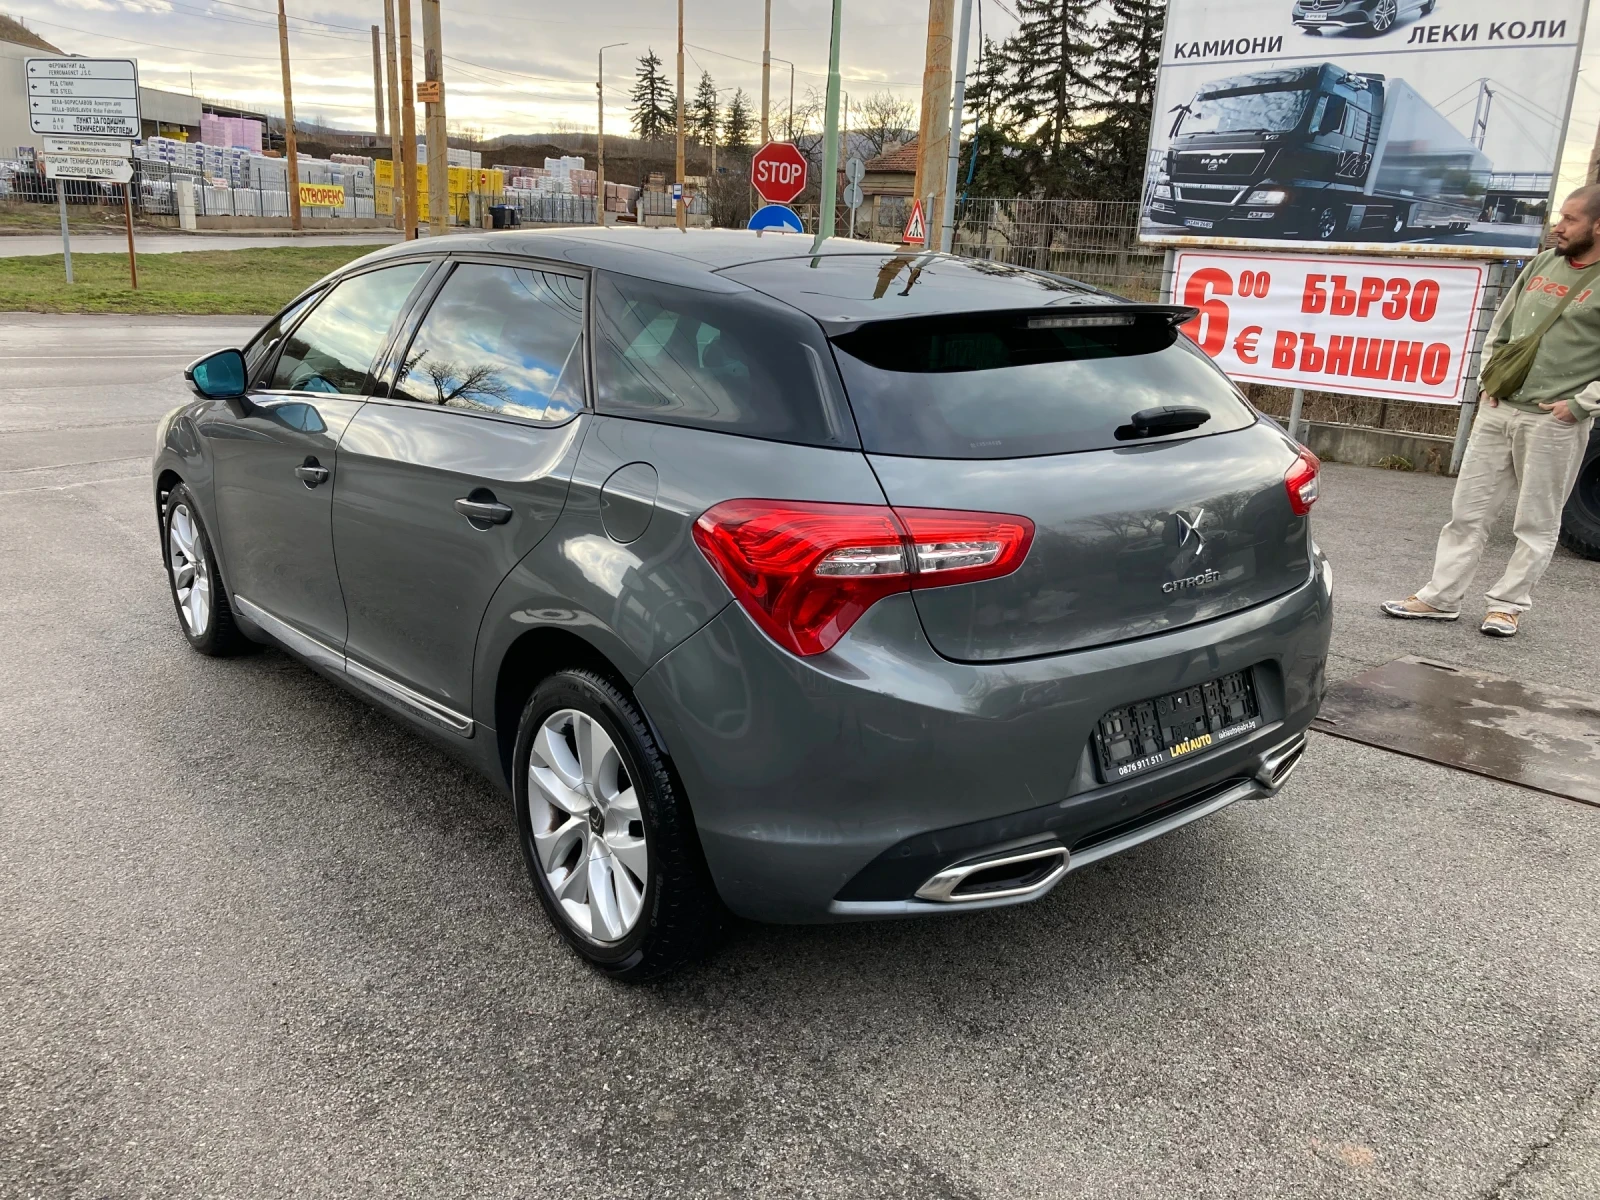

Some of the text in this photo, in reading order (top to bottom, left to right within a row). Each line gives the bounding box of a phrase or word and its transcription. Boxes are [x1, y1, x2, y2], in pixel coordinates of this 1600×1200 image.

[1407, 19, 1566, 44] ЛЕКИ КОЛИ
[1174, 36, 1283, 59] КАМИОНИ
[73, 124, 133, 135] ТЕХНИЧЕСКИ ПРЕГЛЕДИ
[76, 116, 92, 124] ПУНКТ
[100, 117, 126, 125] ГОДИШНИ
[757, 160, 802, 185] STOP
[299, 187, 344, 205] ОТВОРЕНО
[1301, 273, 1440, 322] БЪРЗО
[1525, 276, 1593, 304] Diesl
[1271, 330, 1451, 385] ВЪНШНО
[1190, 733, 1212, 750] AUTO
[1118, 753, 1164, 776] 0876 911 511
